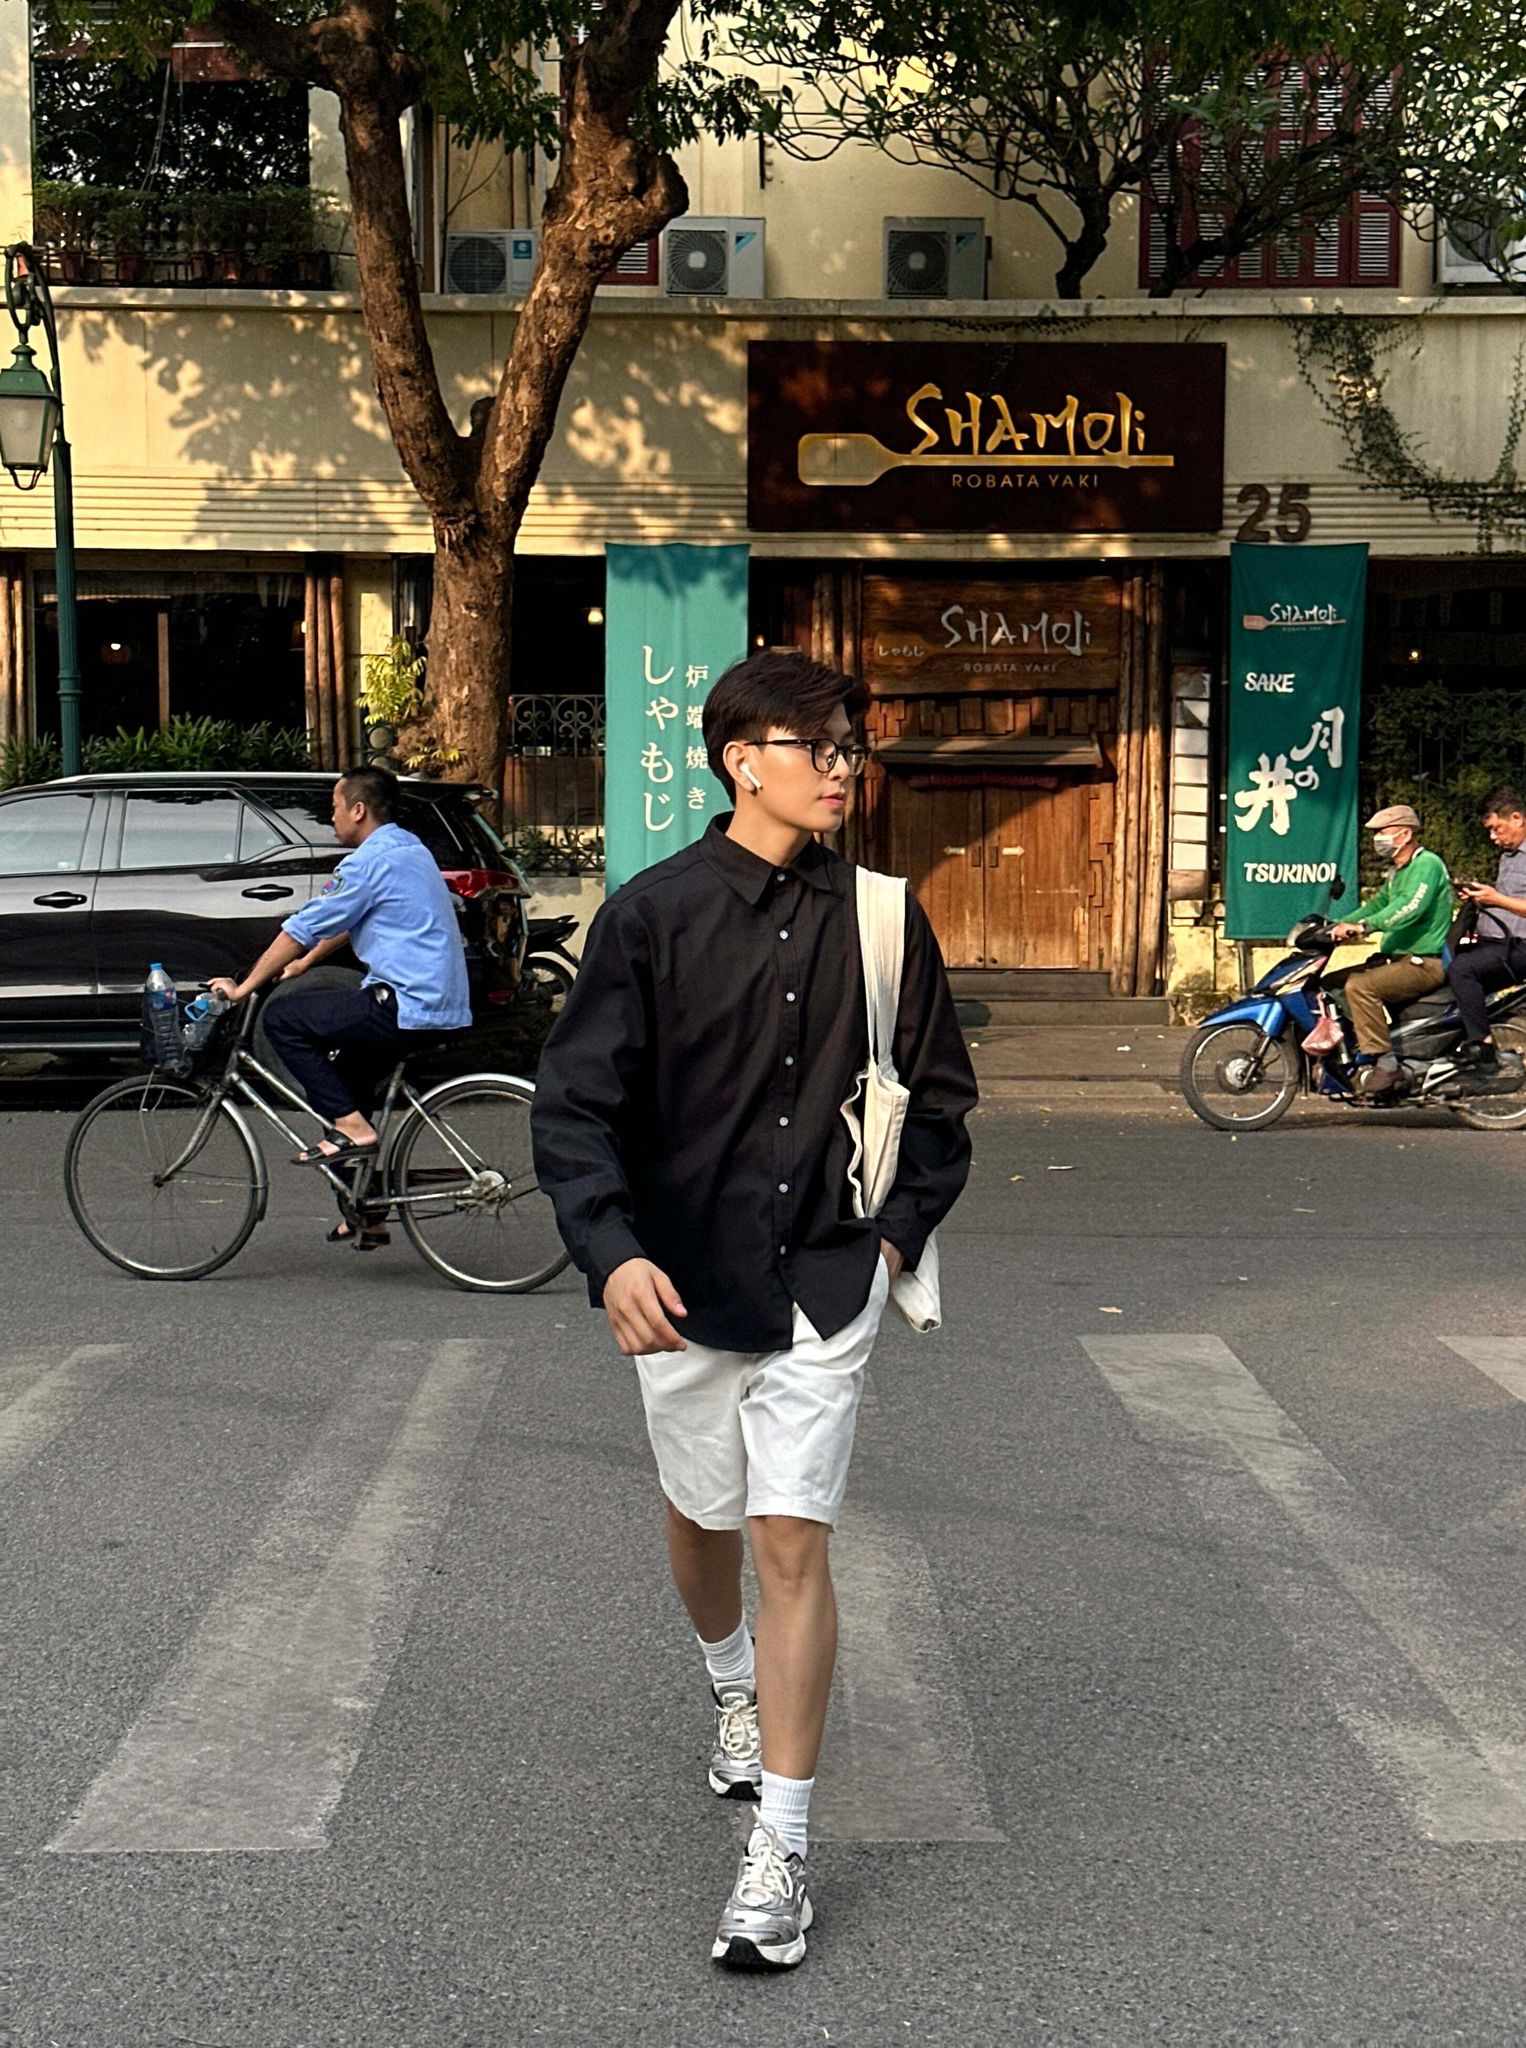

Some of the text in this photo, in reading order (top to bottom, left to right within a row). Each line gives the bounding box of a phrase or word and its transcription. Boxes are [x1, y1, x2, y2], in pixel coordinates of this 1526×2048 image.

[952, 474, 1098, 488] ROBATA YAKI
[1236, 483, 1312, 543] 25
[963, 663, 1057, 673] ROBATA YAKI
[1244, 671, 1296, 693] SAKE
[1243, 862, 1337, 884] TSUKINOI
